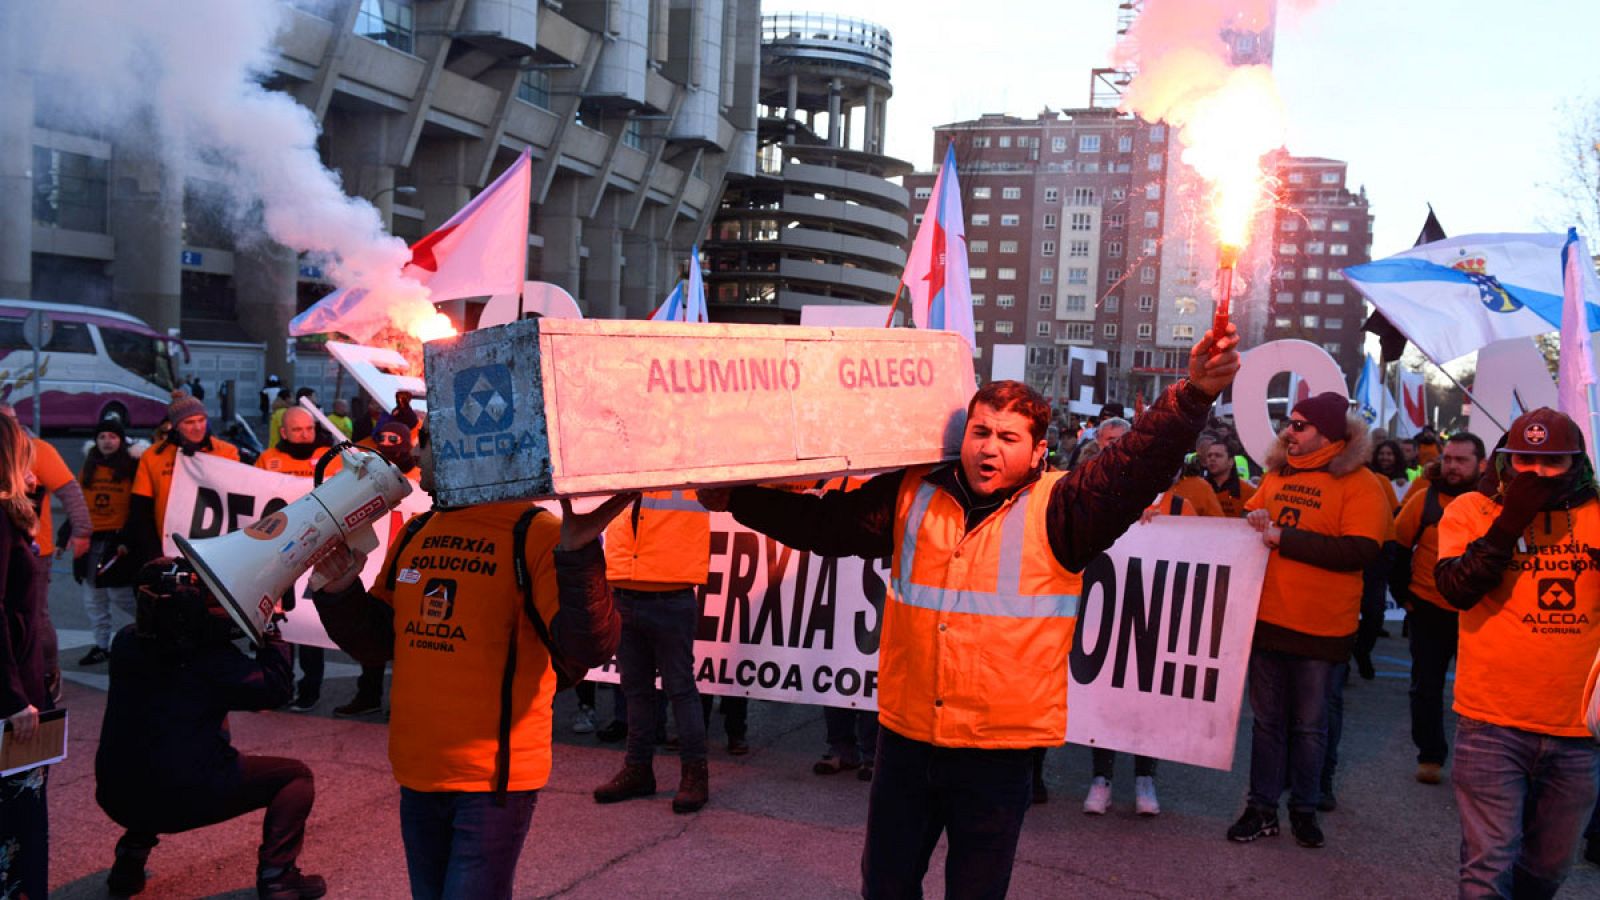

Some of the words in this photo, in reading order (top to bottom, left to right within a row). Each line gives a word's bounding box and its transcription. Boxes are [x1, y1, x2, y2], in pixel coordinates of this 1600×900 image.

[647, 358, 801, 393] ALUMINIO
[838, 357, 934, 388] GALEGO
[441, 431, 538, 460] ALCOA
[422, 536, 496, 555] ENERXÍA
[410, 556, 497, 576] SOLUCIÓN
[1522, 613, 1589, 624] ALCOA
[405, 621, 466, 640] ALCOA
[696, 657, 803, 692] ALCOA
